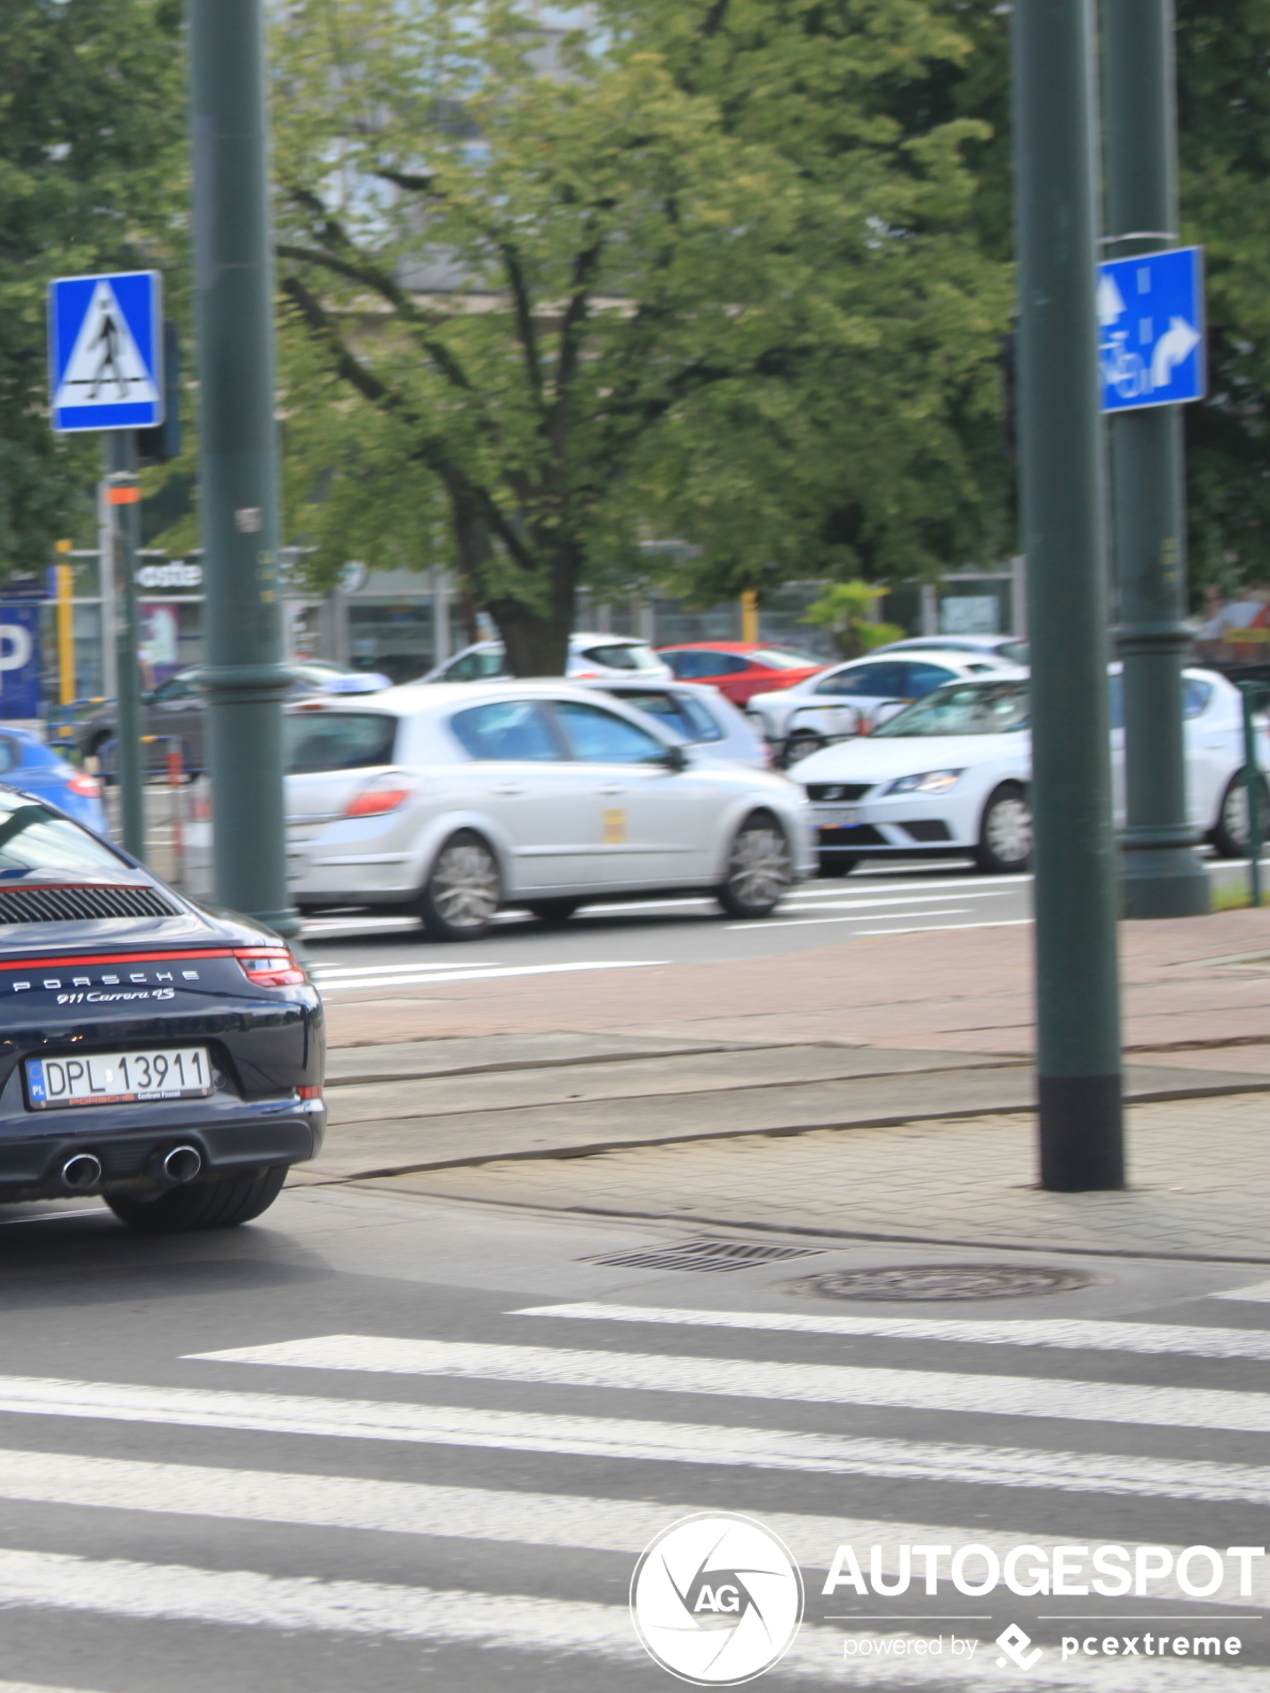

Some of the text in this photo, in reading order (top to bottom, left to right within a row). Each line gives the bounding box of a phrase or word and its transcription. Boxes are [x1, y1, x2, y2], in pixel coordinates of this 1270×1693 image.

[13, 970, 200, 992] PORSCHE
[56, 988, 175, 1005] 911 Carrera 4S
[45, 1052, 203, 1096] DPL 13911
[32, 1085, 45, 1096] PL
[69, 1093, 135, 1106] PORSCHE
[137, 1092, 161, 1100] Centrum
